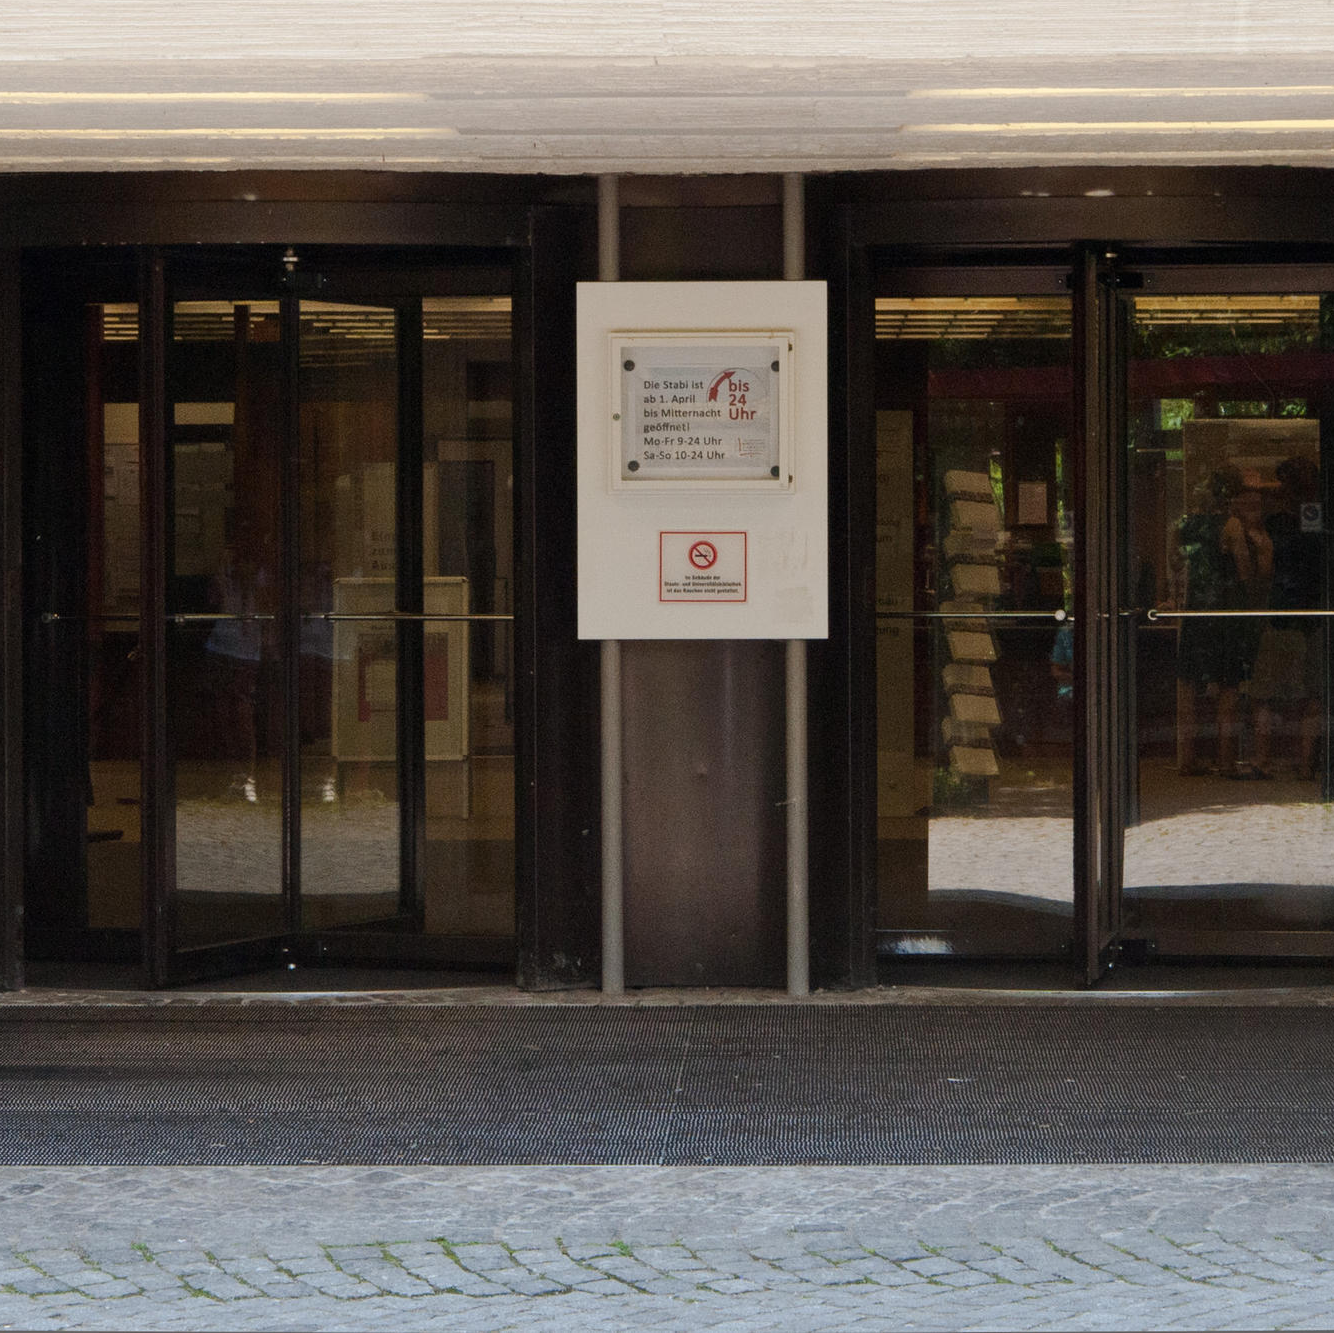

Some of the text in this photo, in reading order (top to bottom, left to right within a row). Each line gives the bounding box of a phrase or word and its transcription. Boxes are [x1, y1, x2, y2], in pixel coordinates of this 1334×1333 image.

[643, 380, 704, 390] Die Stabi ist
[729, 380, 750, 393] bis
[643, 395, 696, 406] ab 1. April
[729, 394, 747, 406] 24
[643, 408, 721, 418] bis Mitternacht
[729, 407, 757, 420] Uhr
[643, 436, 723, 446] Mo-Fr 9-24 Uhr
[643, 450, 725, 460] Sa-So 10-24 Uhr
